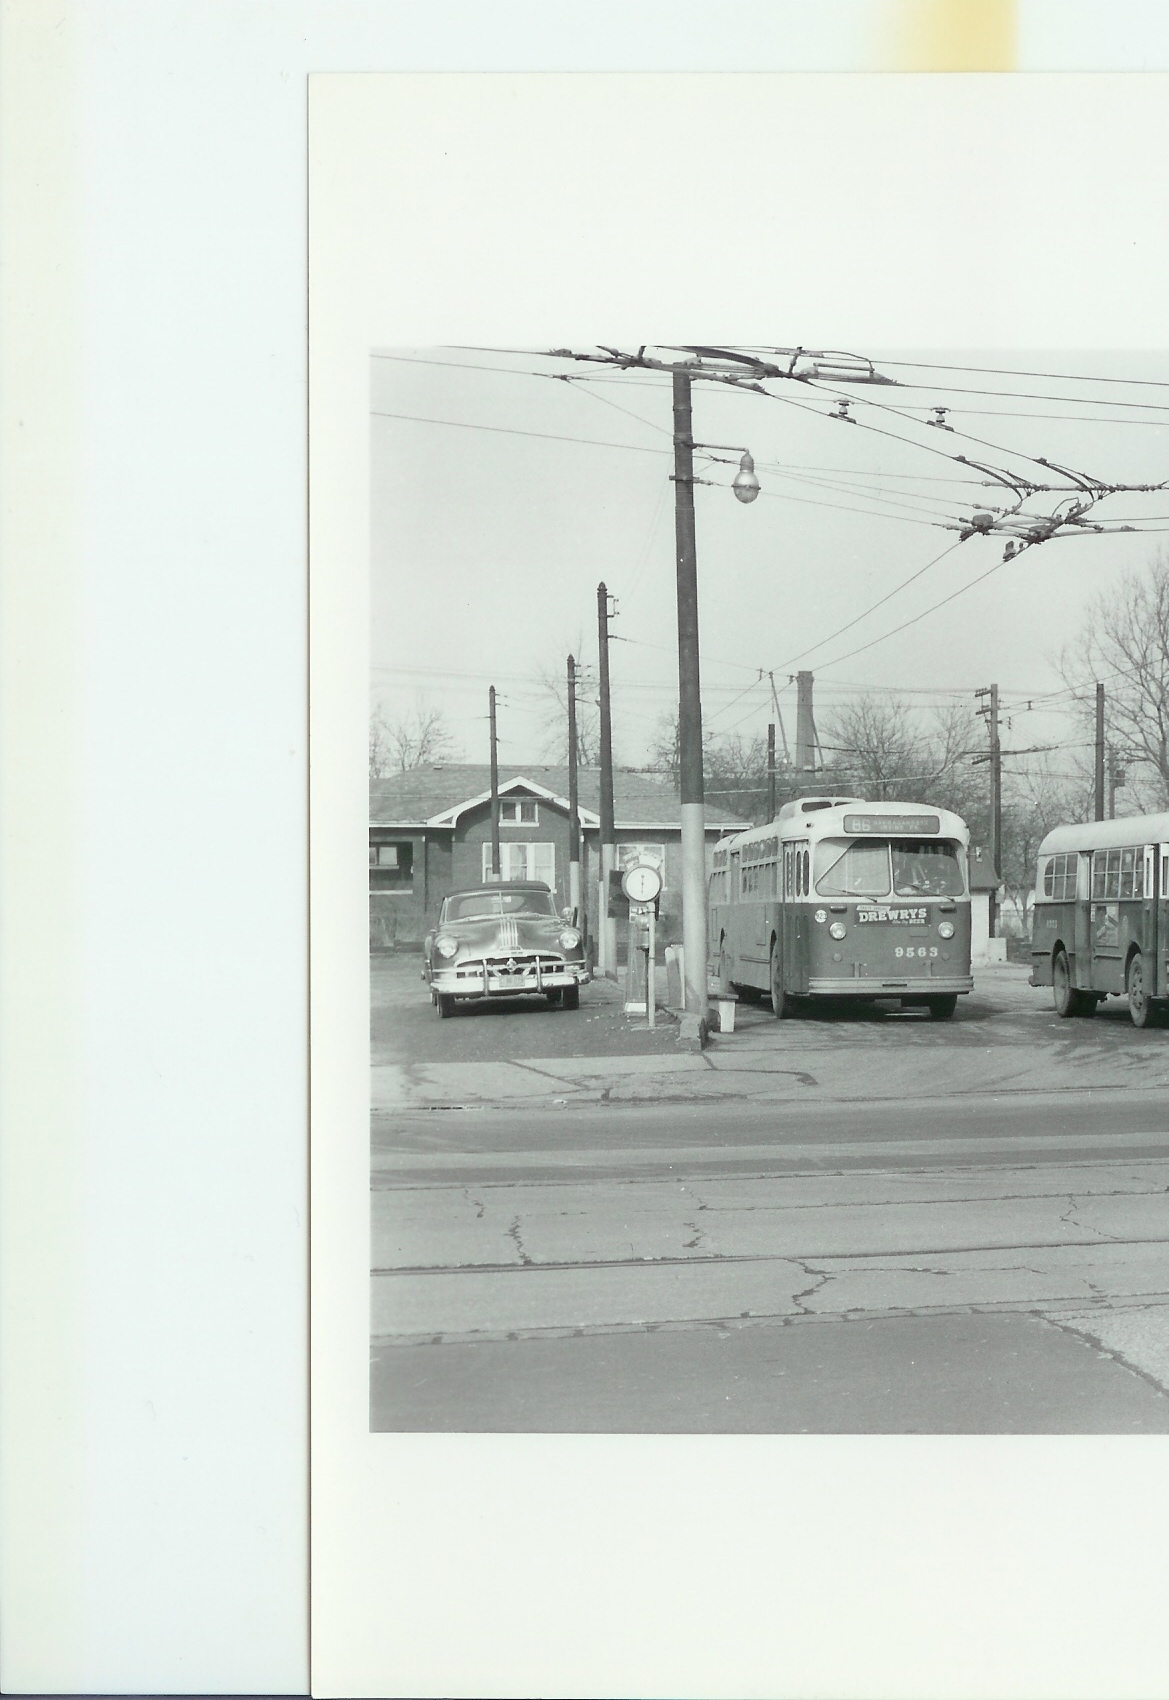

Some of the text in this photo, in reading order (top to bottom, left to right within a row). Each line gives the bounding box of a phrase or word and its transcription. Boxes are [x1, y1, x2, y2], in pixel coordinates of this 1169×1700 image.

[852, 819, 870, 831] 86
[859, 908, 927, 922] DREWRYS
[895, 946, 938, 958] 9563
